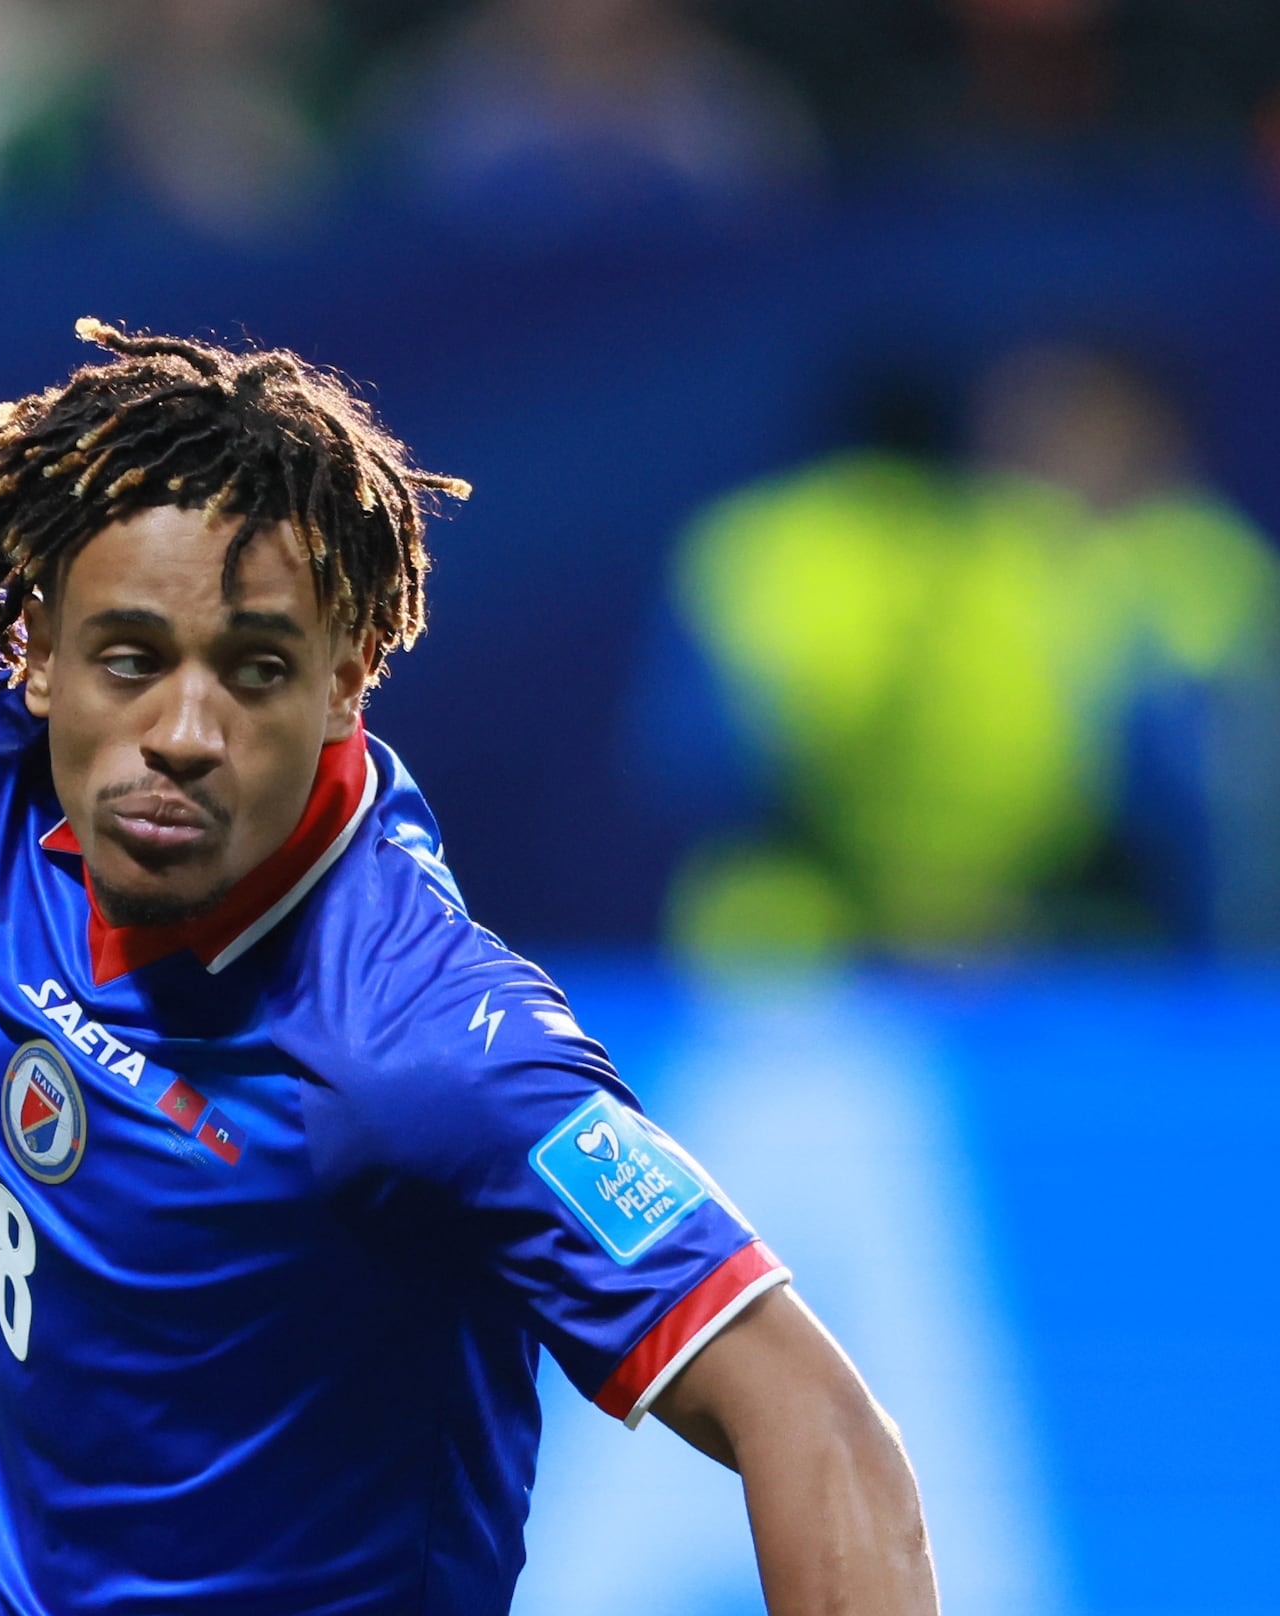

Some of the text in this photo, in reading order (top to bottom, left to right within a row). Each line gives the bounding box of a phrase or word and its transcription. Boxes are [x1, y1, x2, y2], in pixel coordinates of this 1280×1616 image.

[18, 979, 146, 1087] SAETA
[34, 1071, 61, 1105] HAITI
[596, 1161, 636, 1201] Unite
[615, 1165, 673, 1219] PEACE
[643, 1195, 675, 1224] FIFA
